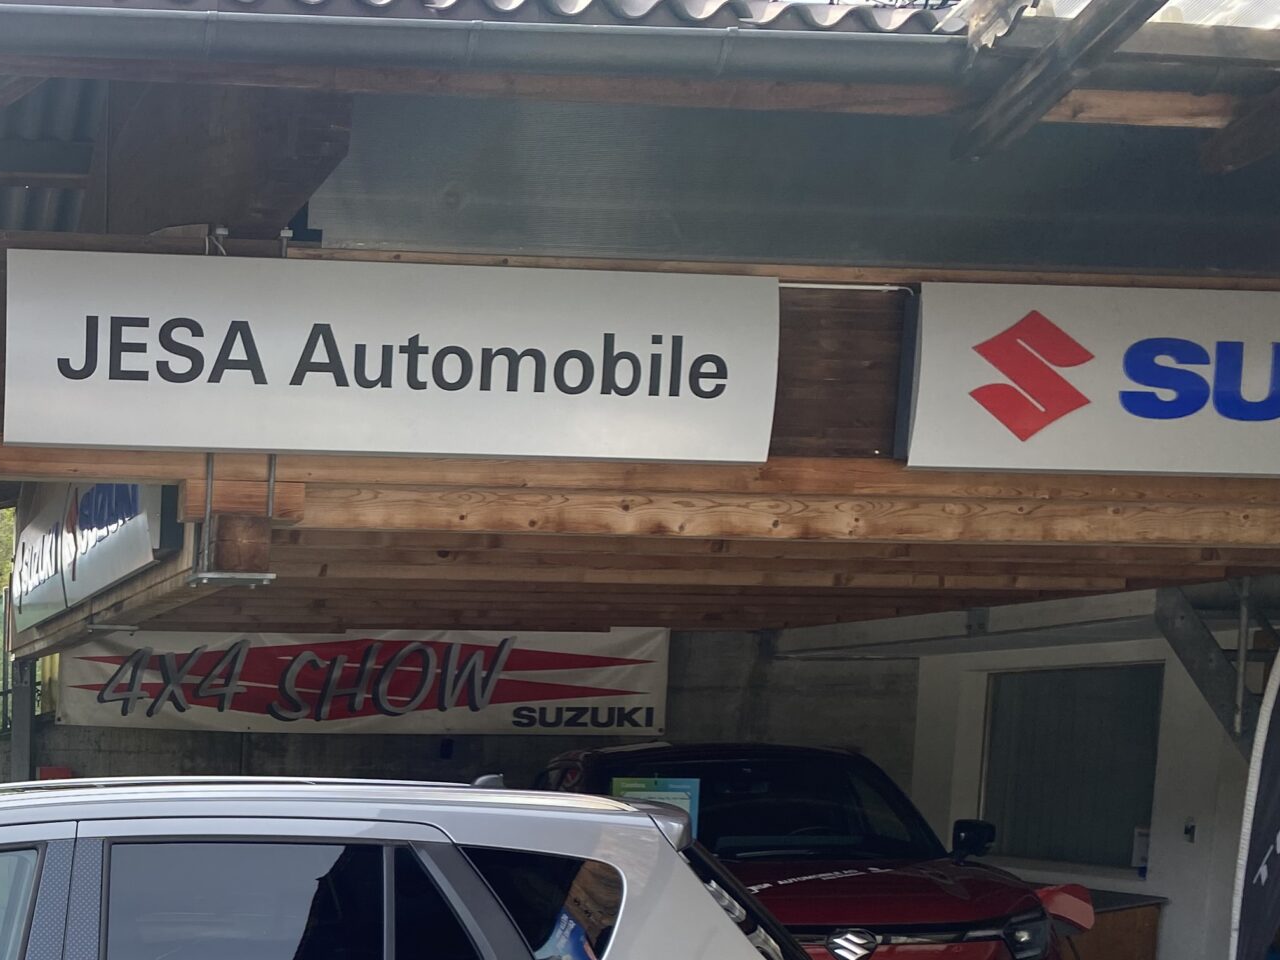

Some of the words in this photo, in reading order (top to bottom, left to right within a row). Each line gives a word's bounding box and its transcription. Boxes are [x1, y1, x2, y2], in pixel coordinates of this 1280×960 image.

[56, 314, 268, 386] JESA
[289, 323, 729, 399] Automobile
[267, 635, 518, 722] SHOW
[512, 706, 654, 729] SUZUKI
